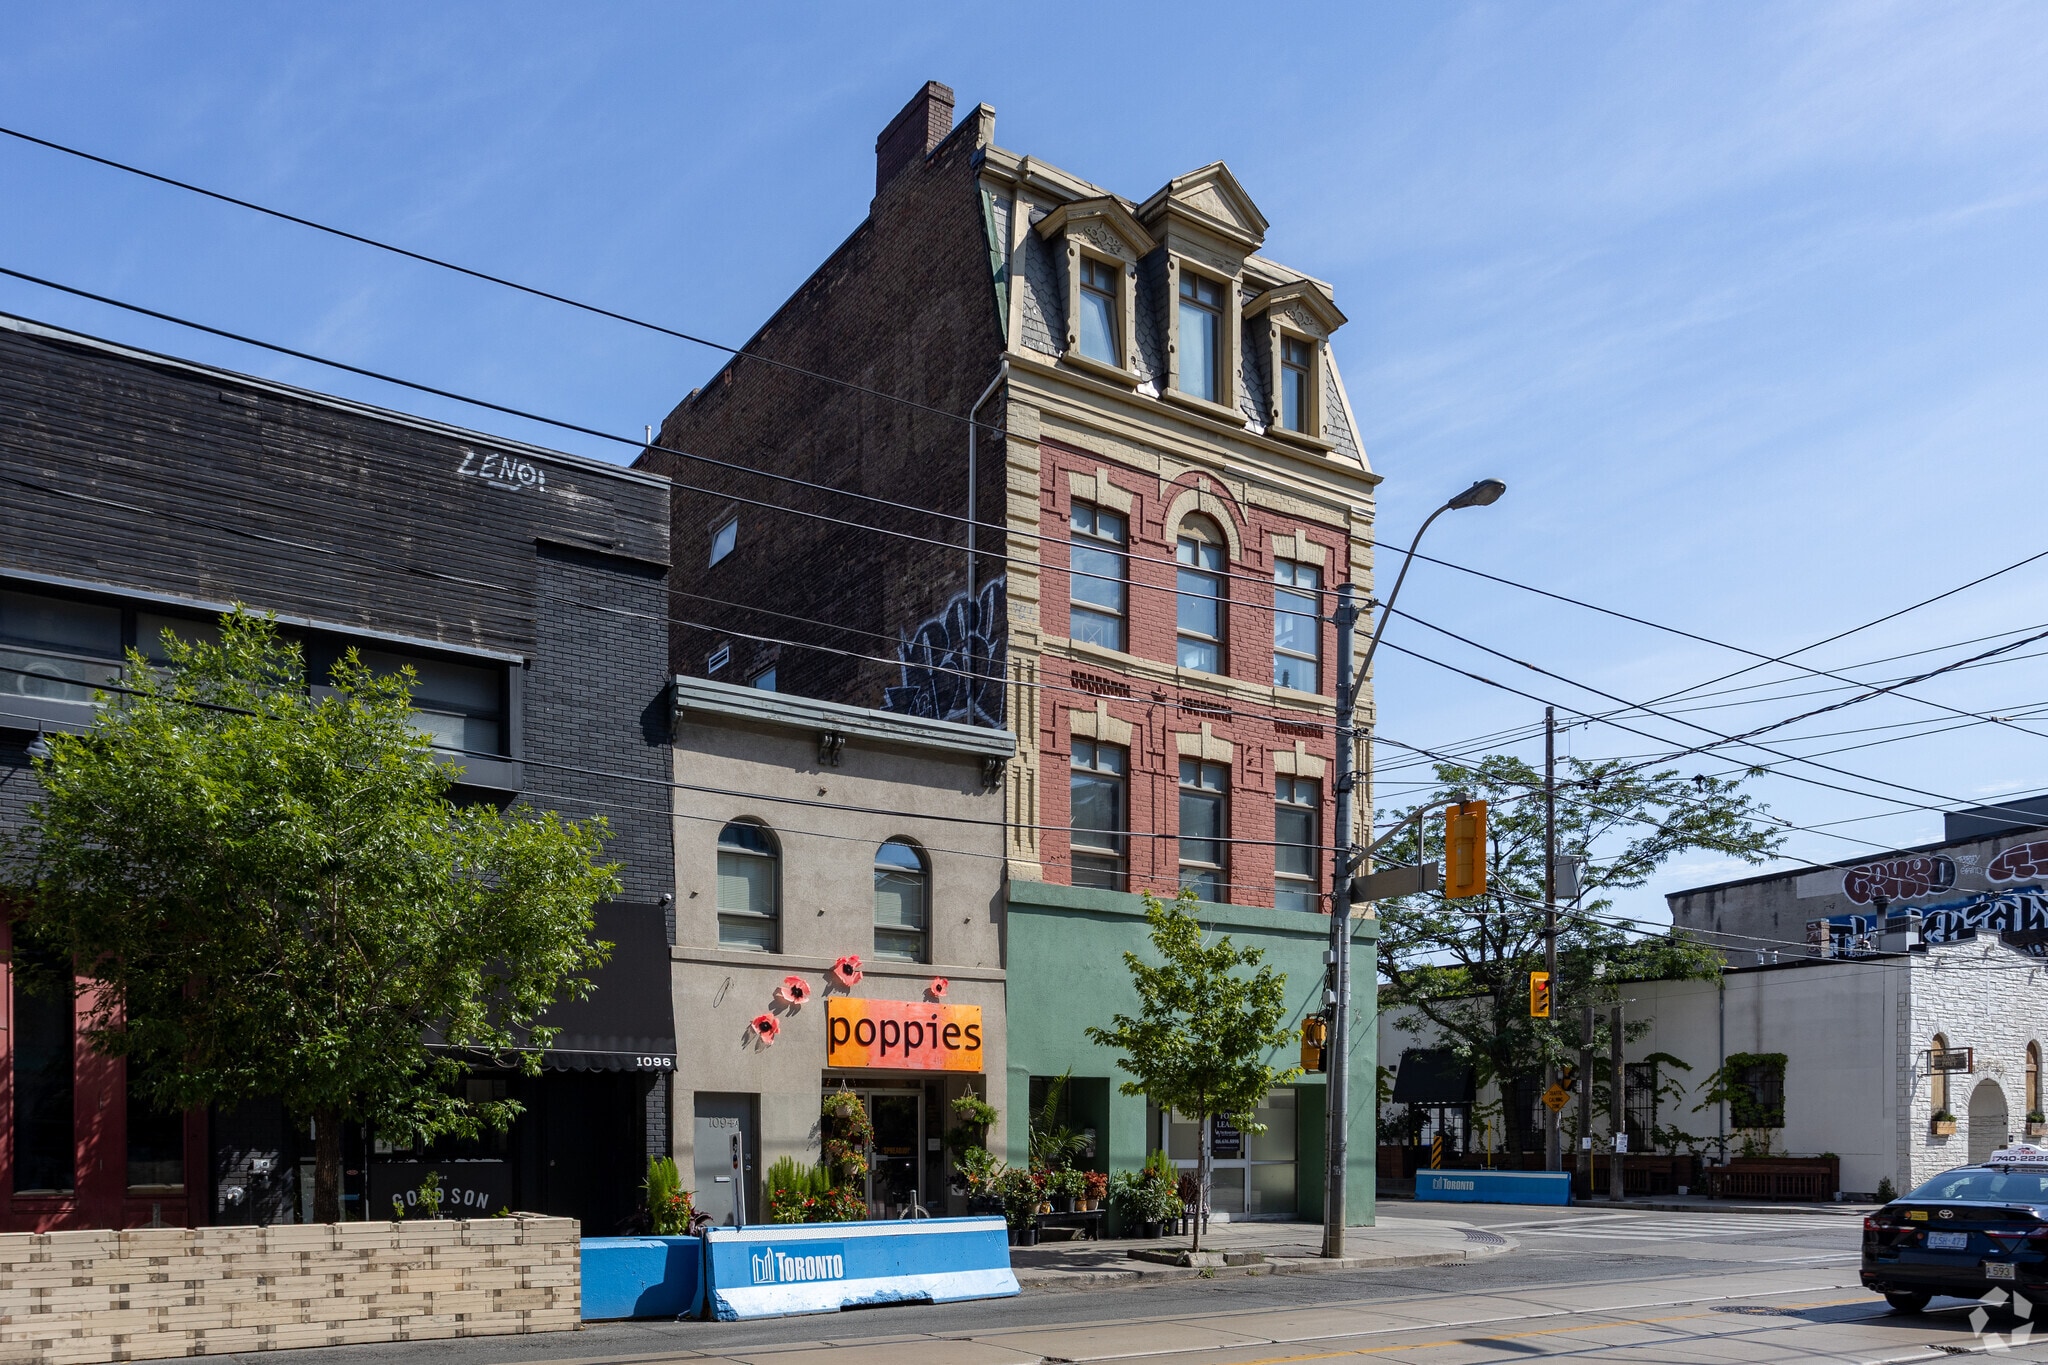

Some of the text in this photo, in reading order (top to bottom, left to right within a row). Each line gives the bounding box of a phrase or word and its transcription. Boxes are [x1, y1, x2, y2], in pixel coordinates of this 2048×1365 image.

[830, 1014, 981, 1058] poppies
[636, 1056, 671, 1067] 1096
[1442, 1178, 1475, 1191] TORONTO
[392, 1187, 490, 1209] GOD SON
[775, 1252, 844, 1282] TORONTO
[1993, 1266, 2010, 1276] 593
